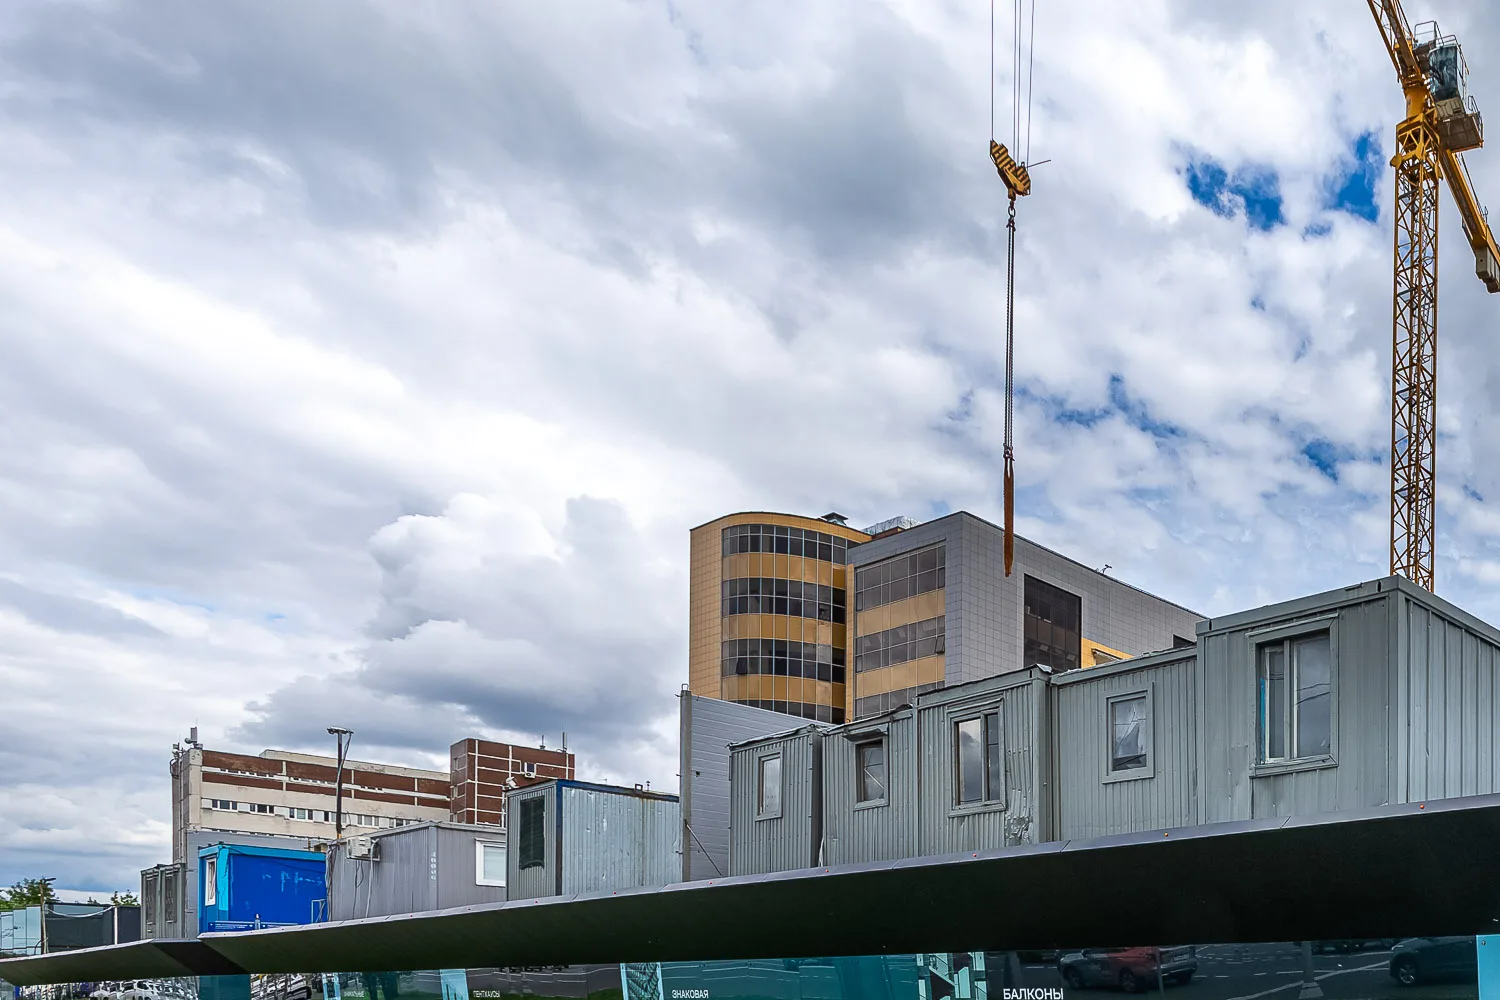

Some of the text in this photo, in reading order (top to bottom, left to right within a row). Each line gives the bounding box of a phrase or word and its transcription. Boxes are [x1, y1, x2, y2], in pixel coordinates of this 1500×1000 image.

[473, 990, 501, 998] ПЕНТХАУСЫ
[672, 990, 709, 1000] ЗНАКОВАЯ
[1003, 988, 1064, 1000] БАЛКОНЫ
